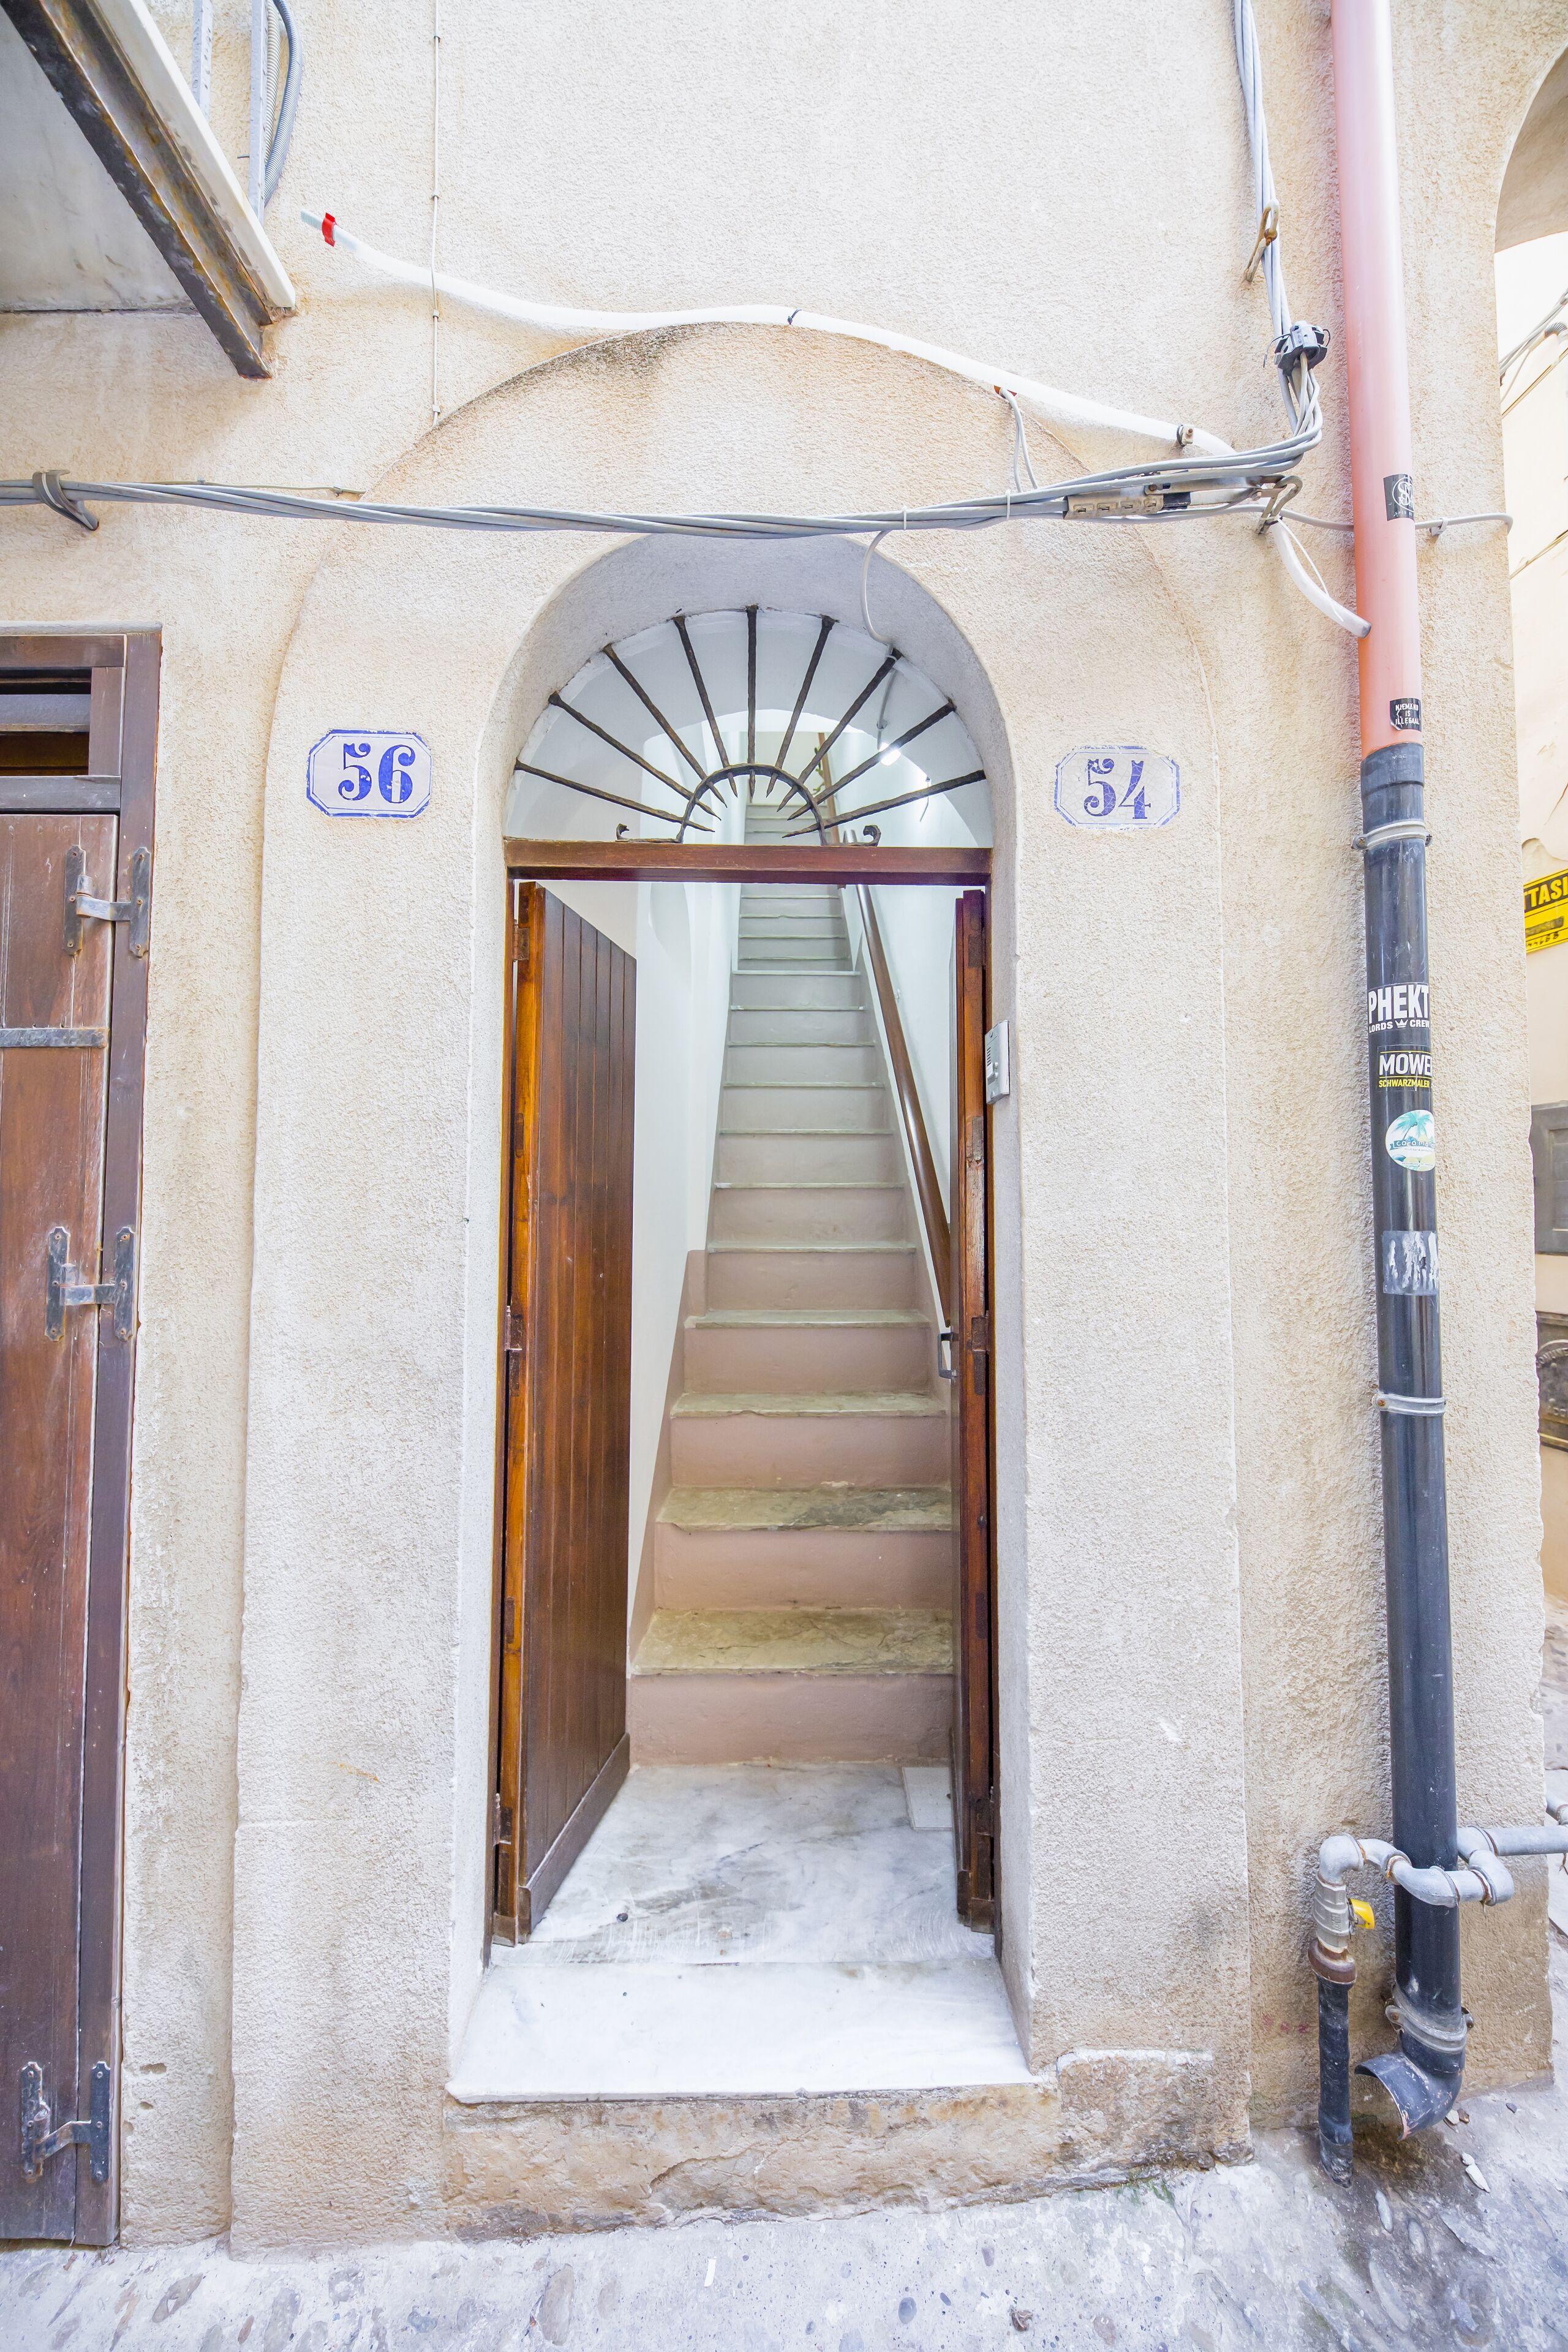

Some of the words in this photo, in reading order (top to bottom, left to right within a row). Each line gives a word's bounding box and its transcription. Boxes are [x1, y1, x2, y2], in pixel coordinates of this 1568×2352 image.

[338, 742, 416, 804] 56
[1084, 758, 1152, 820] 54
[1368, 984, 1429, 1025] PHEKT
[1369, 1020, 1393, 1033] LORDS
[1409, 1019, 1430, 1028] CREW
[1378, 1079, 1430, 1088] SCHWARZMALER
